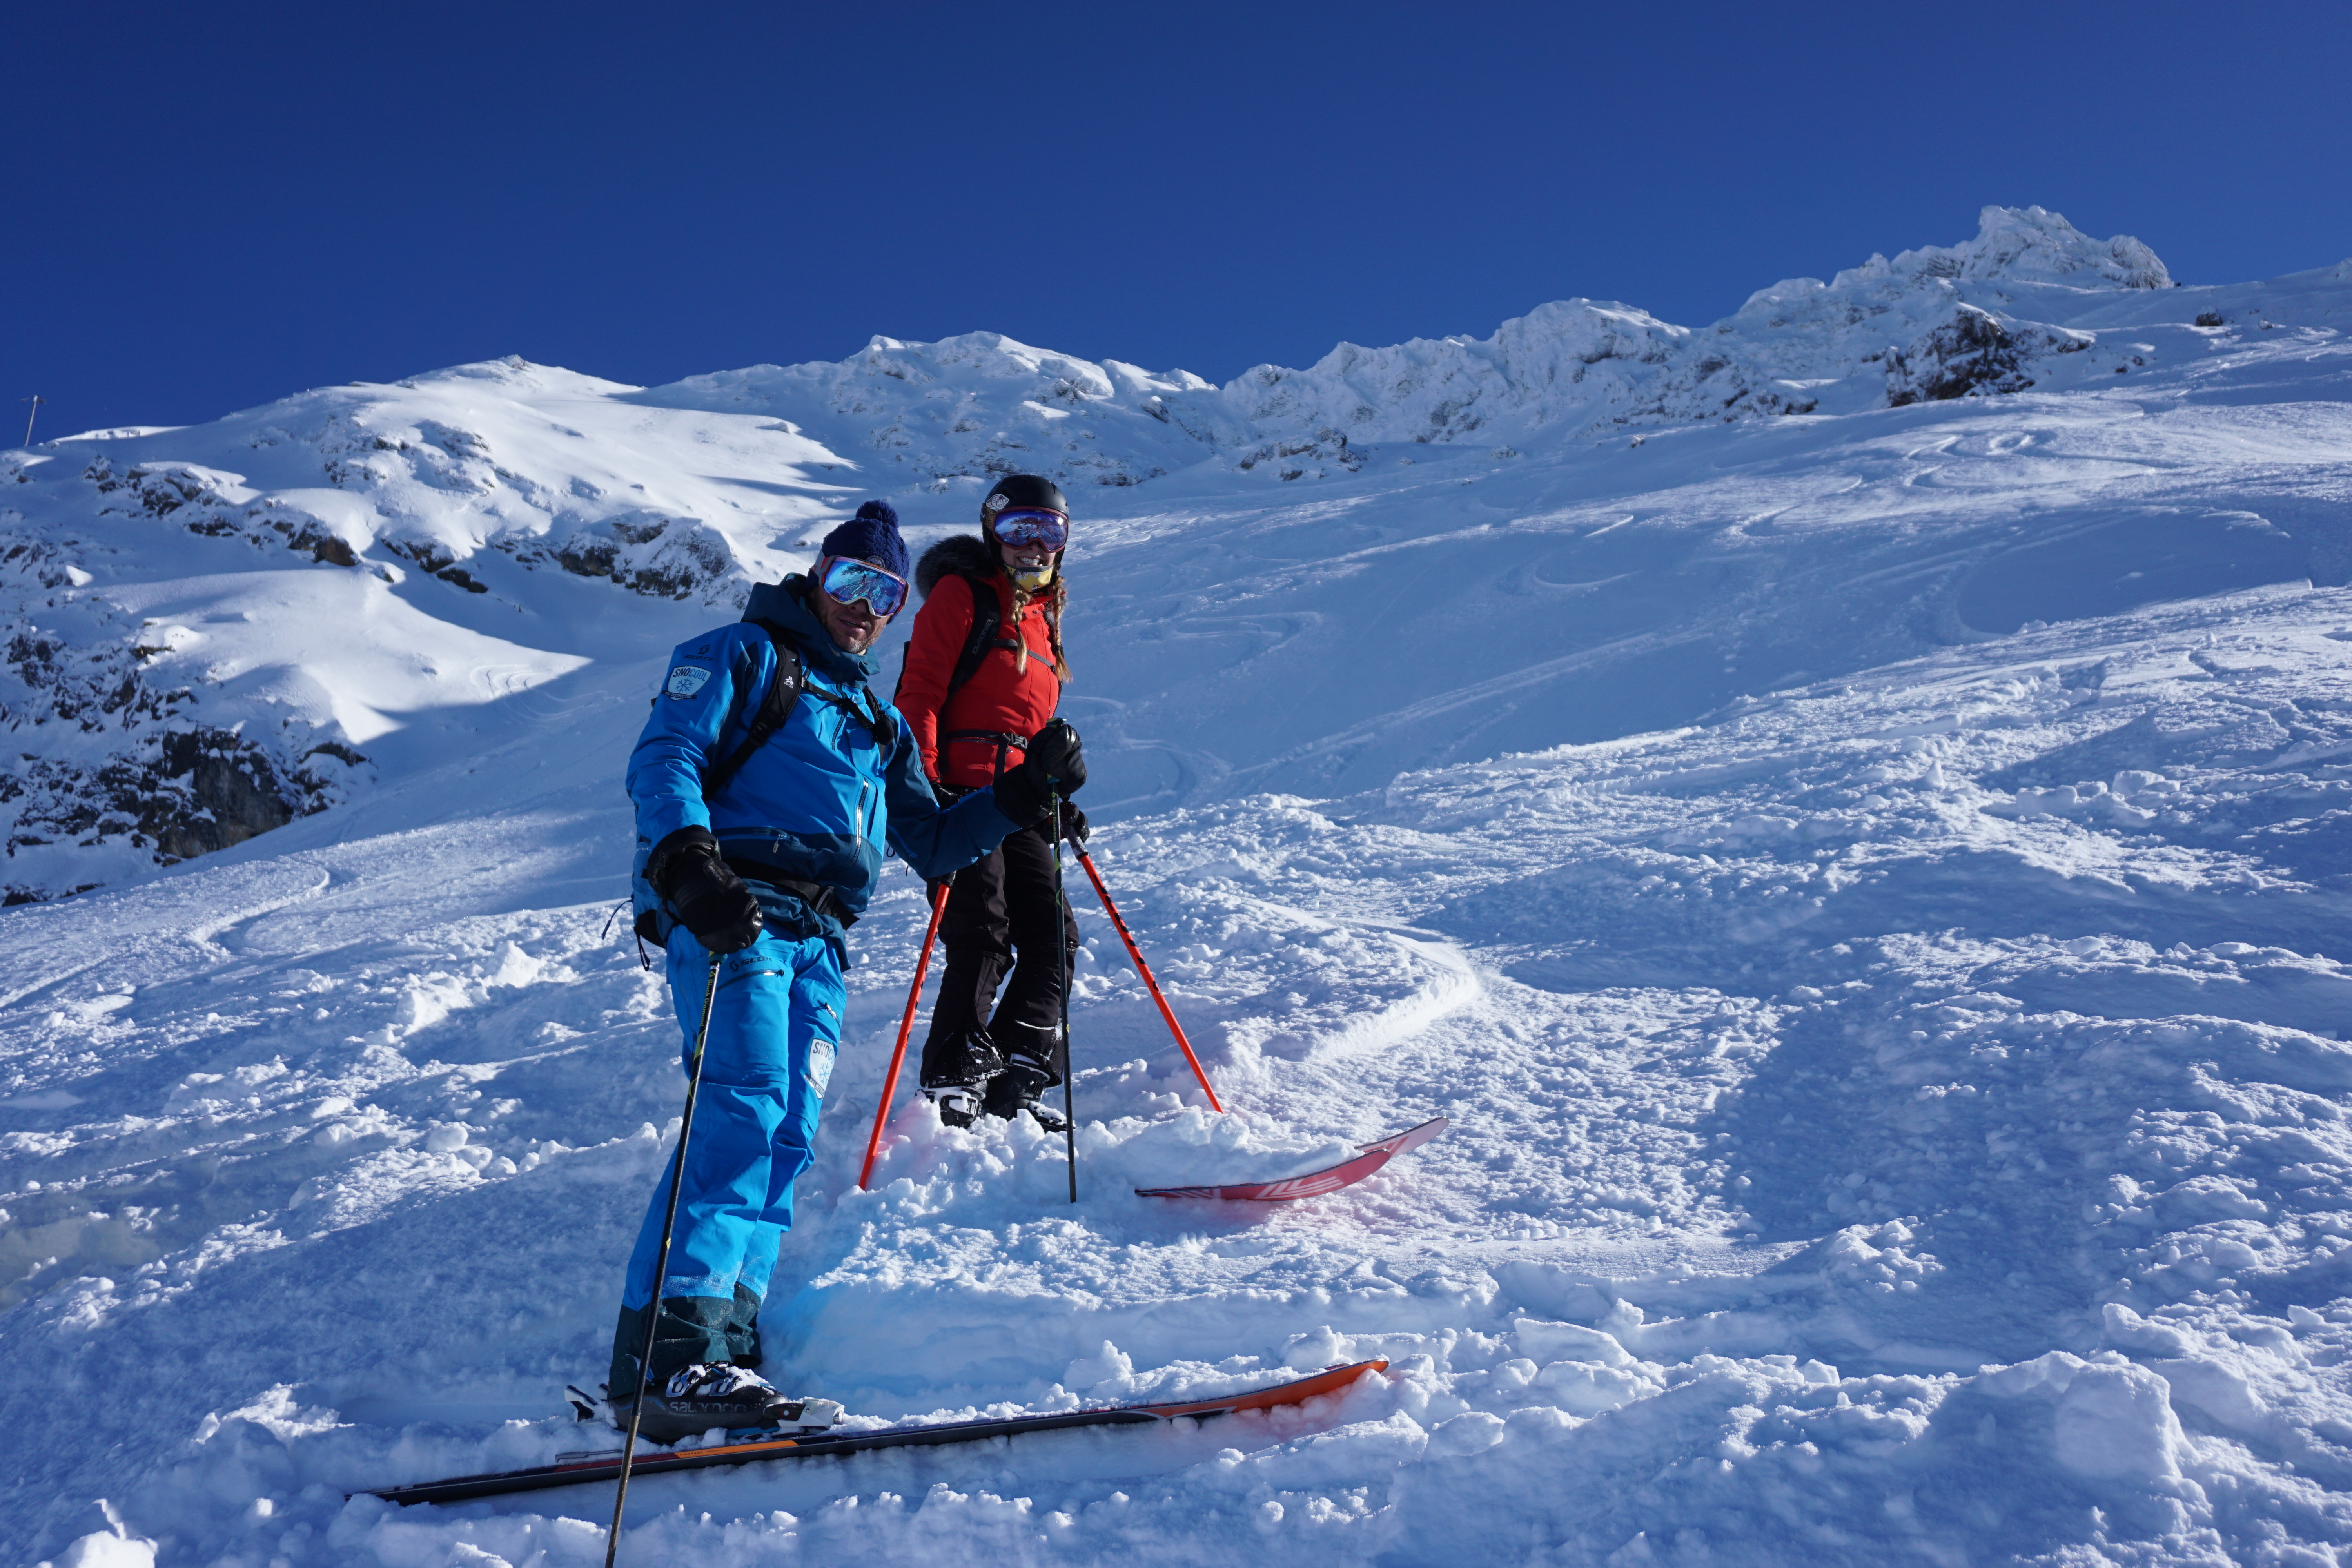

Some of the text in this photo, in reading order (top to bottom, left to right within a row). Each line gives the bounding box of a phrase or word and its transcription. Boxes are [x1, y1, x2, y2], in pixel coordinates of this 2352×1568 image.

[972, 619, 993, 655] DAKINE
[673, 668, 707, 682] SNOCOOL
[740, 956, 772, 966] SCOTT
[700, 998, 710, 1027] Diamond
